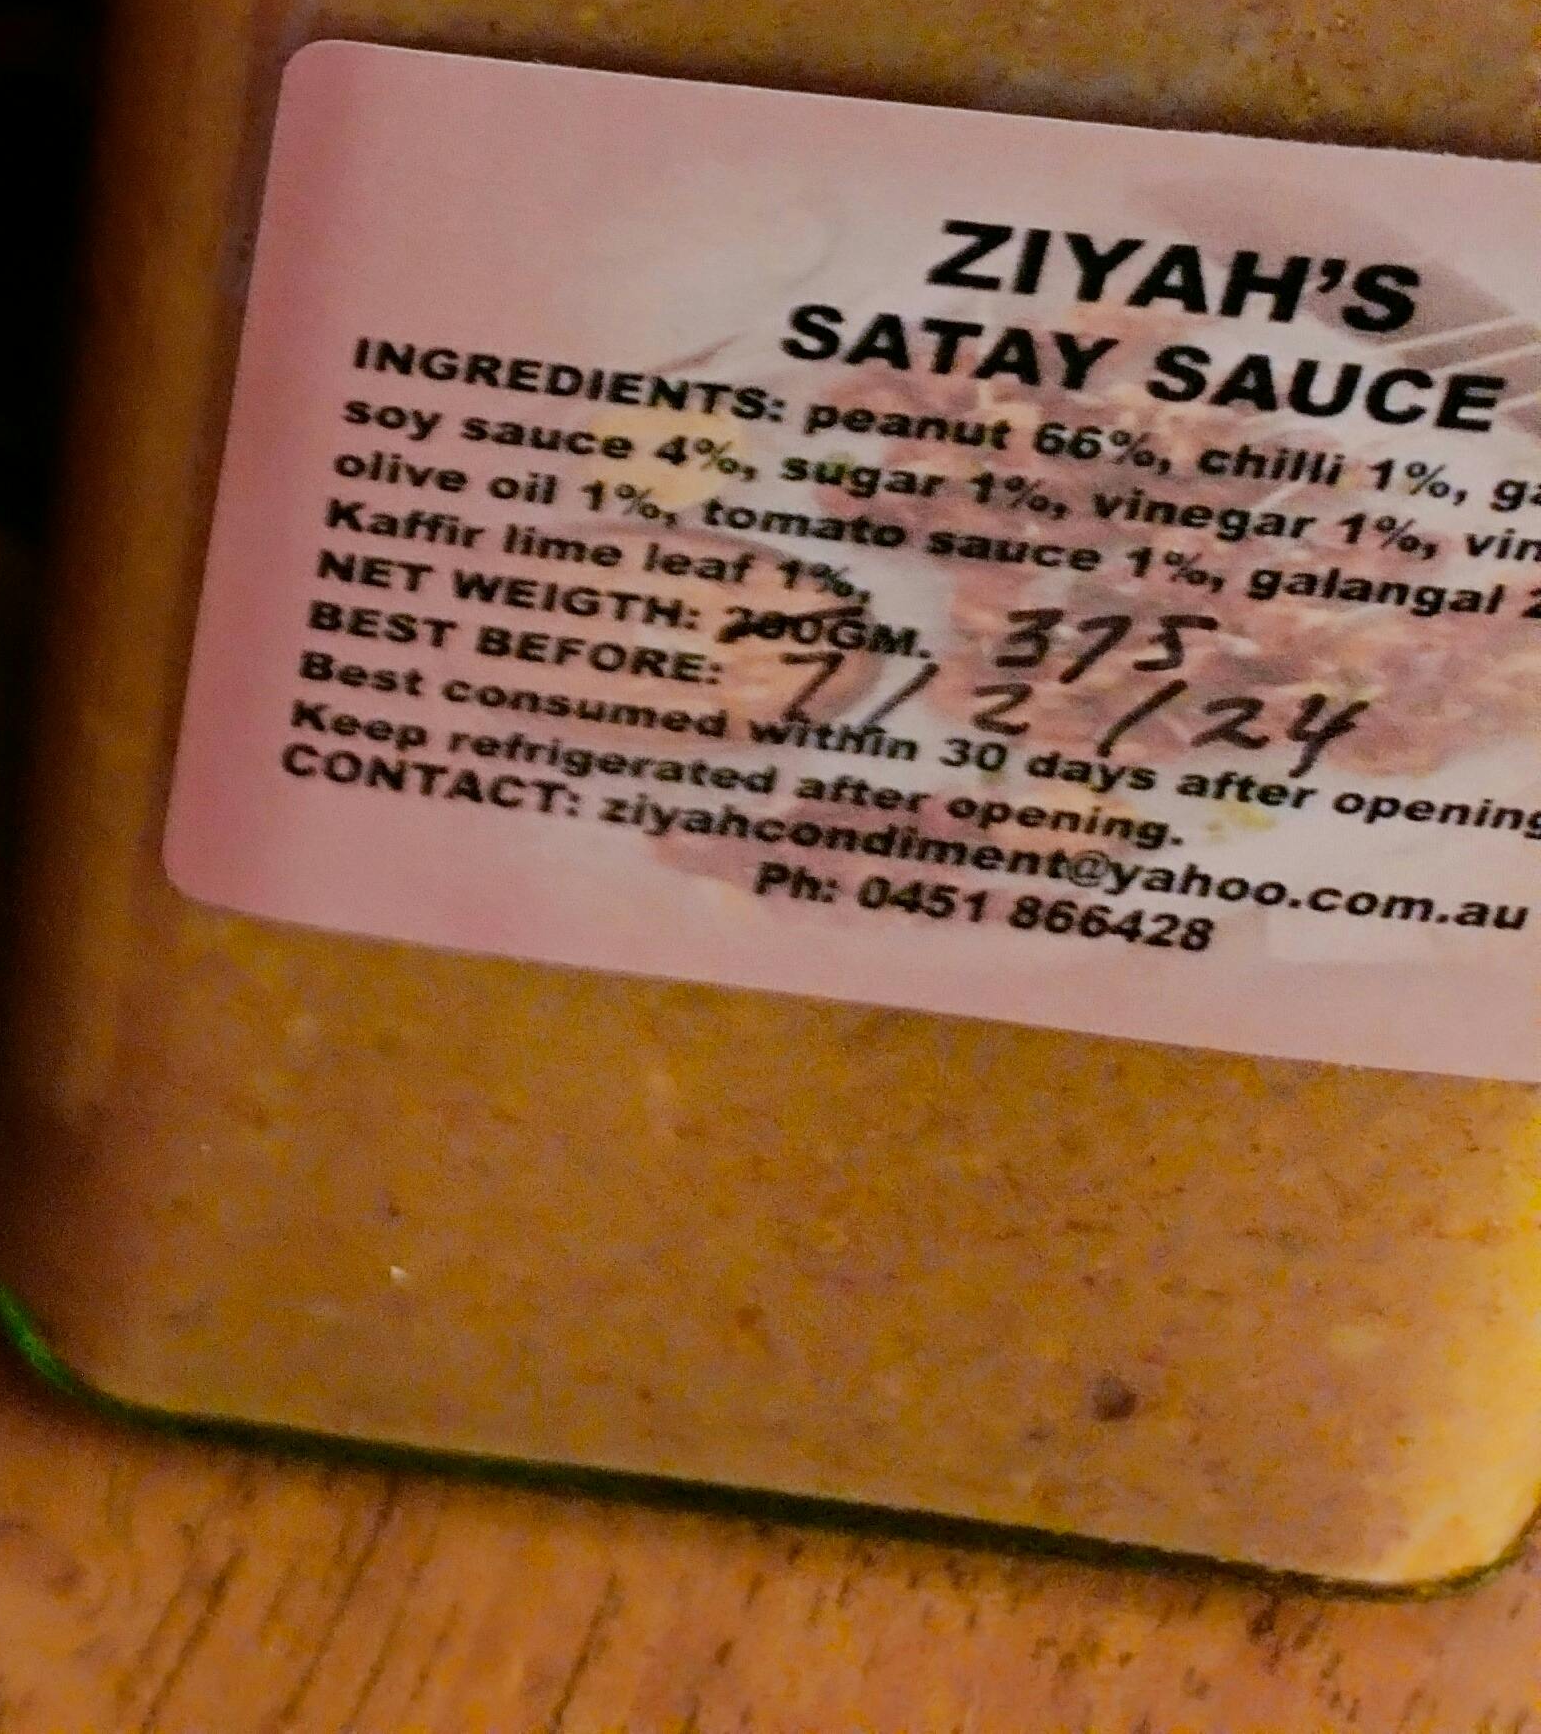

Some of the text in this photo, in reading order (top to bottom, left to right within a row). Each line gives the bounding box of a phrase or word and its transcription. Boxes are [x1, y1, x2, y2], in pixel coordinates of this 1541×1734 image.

[926, 219, 1419, 334] ZIYAH'S
[354, 336, 786, 422] INGREDIENTS:
[805, 402, 1009, 450] peanut
[1033, 421, 1172, 476] 66%,
[1196, 443, 1344, 487] chilli
[1371, 458, 1466, 507] 1%,
[780, 303, 1506, 432] SATAY SAUCE
[334, 448, 467, 493] olive
[487, 470, 557, 506] oil
[581, 480, 678, 528] 1%,
[701, 497, 907, 552] tomato
[926, 525, 1101, 573] sauce
[1126, 544, 1224, 592] 1%,
[1247, 564, 1506, 618] galangal
[343, 396, 441, 440] soy
[462, 413, 634, 459] sauce
[655, 434, 757, 482] 4%,
[779, 454, 945, 498] sugar
[972, 470, 1066, 518] 1%,
[1093, 487, 1317, 542] vinegar
[1340, 510, 1438, 559] 1%,
[316, 549, 433, 592] NET
[452, 568, 701, 631] WEIGTH:
[325, 498, 484, 547] Kaffir
[502, 523, 622, 565] lime
[642, 541, 756, 587] leaf
[307, 600, 722, 684] BEST BEFORE:
[996, 608, 1218, 684] 375
[291, 699, 1183, 850] Keep refrigerated after opening.
[299, 651, 423, 696] Best
[442, 677, 727, 739] consumed
[749, 714, 919, 761] within
[939, 736, 1007, 771] 30
[1025, 750, 1158, 794] days
[1176, 770, 1318, 813] after
[281, 742, 1528, 932] CONTACT: ziyahcondiment@yahoo.com.au
[753, 862, 1216, 953] Ph: 0451 866428
